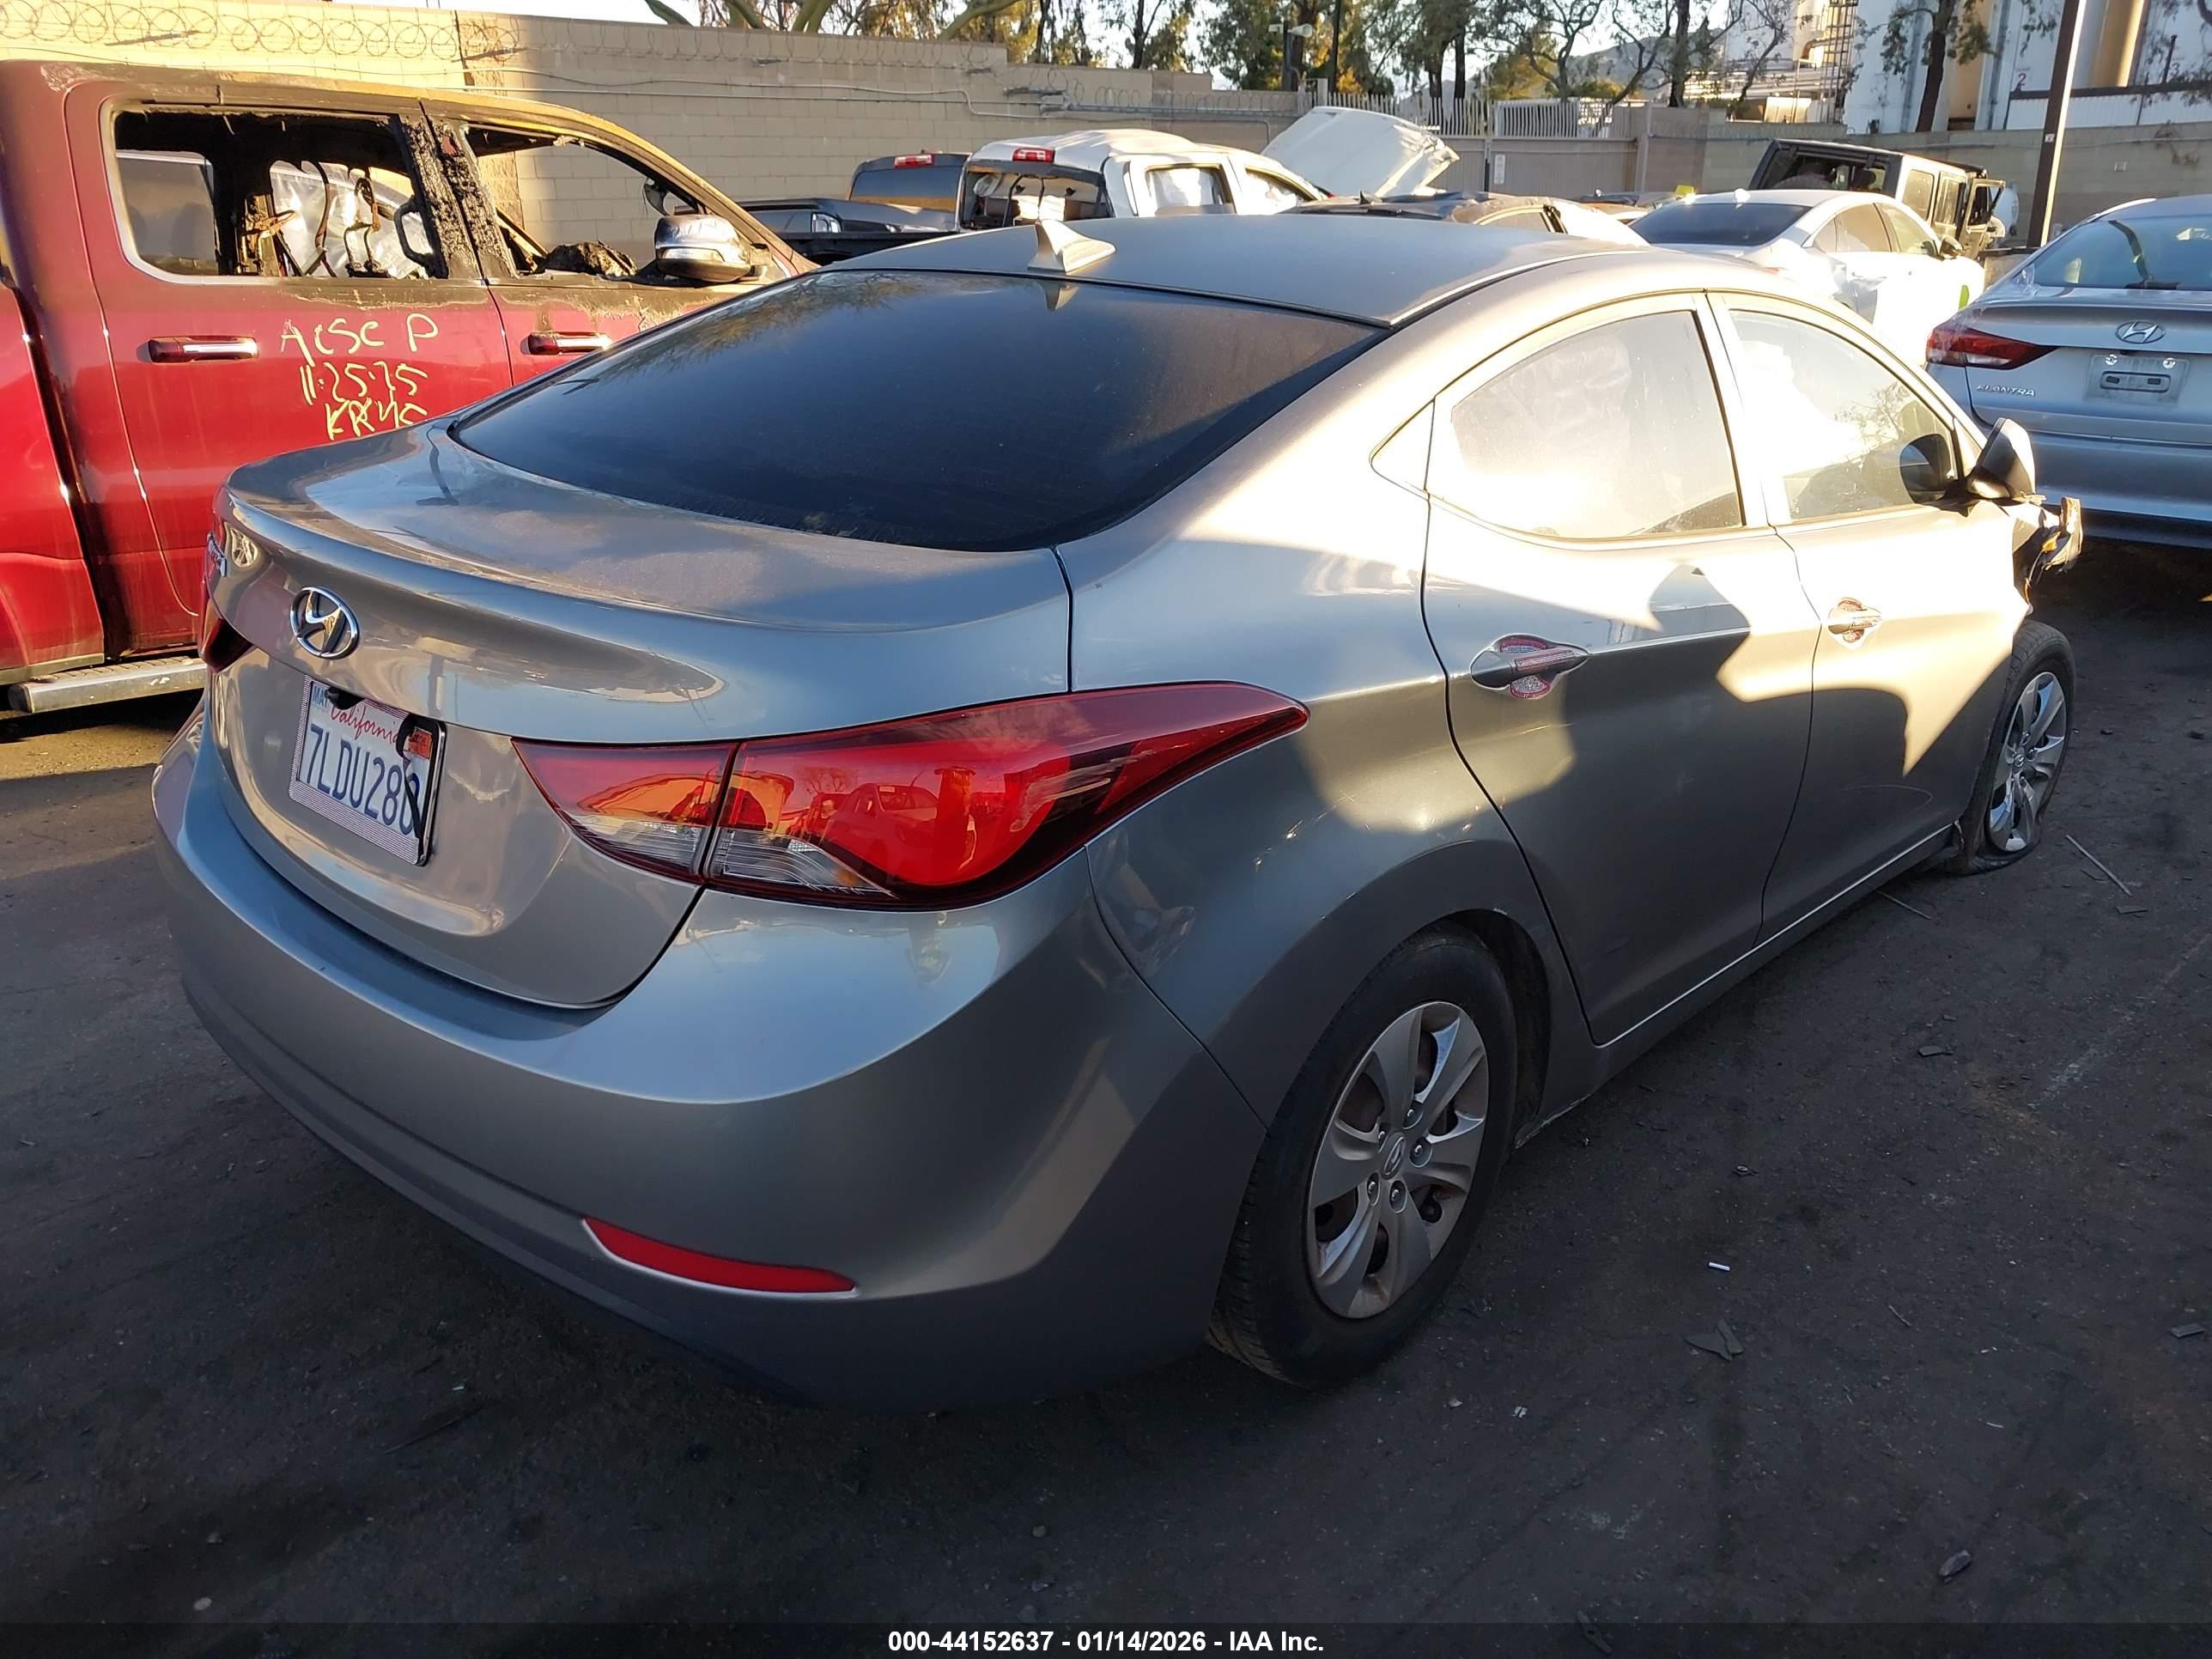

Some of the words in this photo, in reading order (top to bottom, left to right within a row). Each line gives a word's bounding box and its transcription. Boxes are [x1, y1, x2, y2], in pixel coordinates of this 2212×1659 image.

[2018, 72, 2027, 86] 2
[406, 313, 439, 352] P
[1977, 384, 2036, 397] ELANTRA
